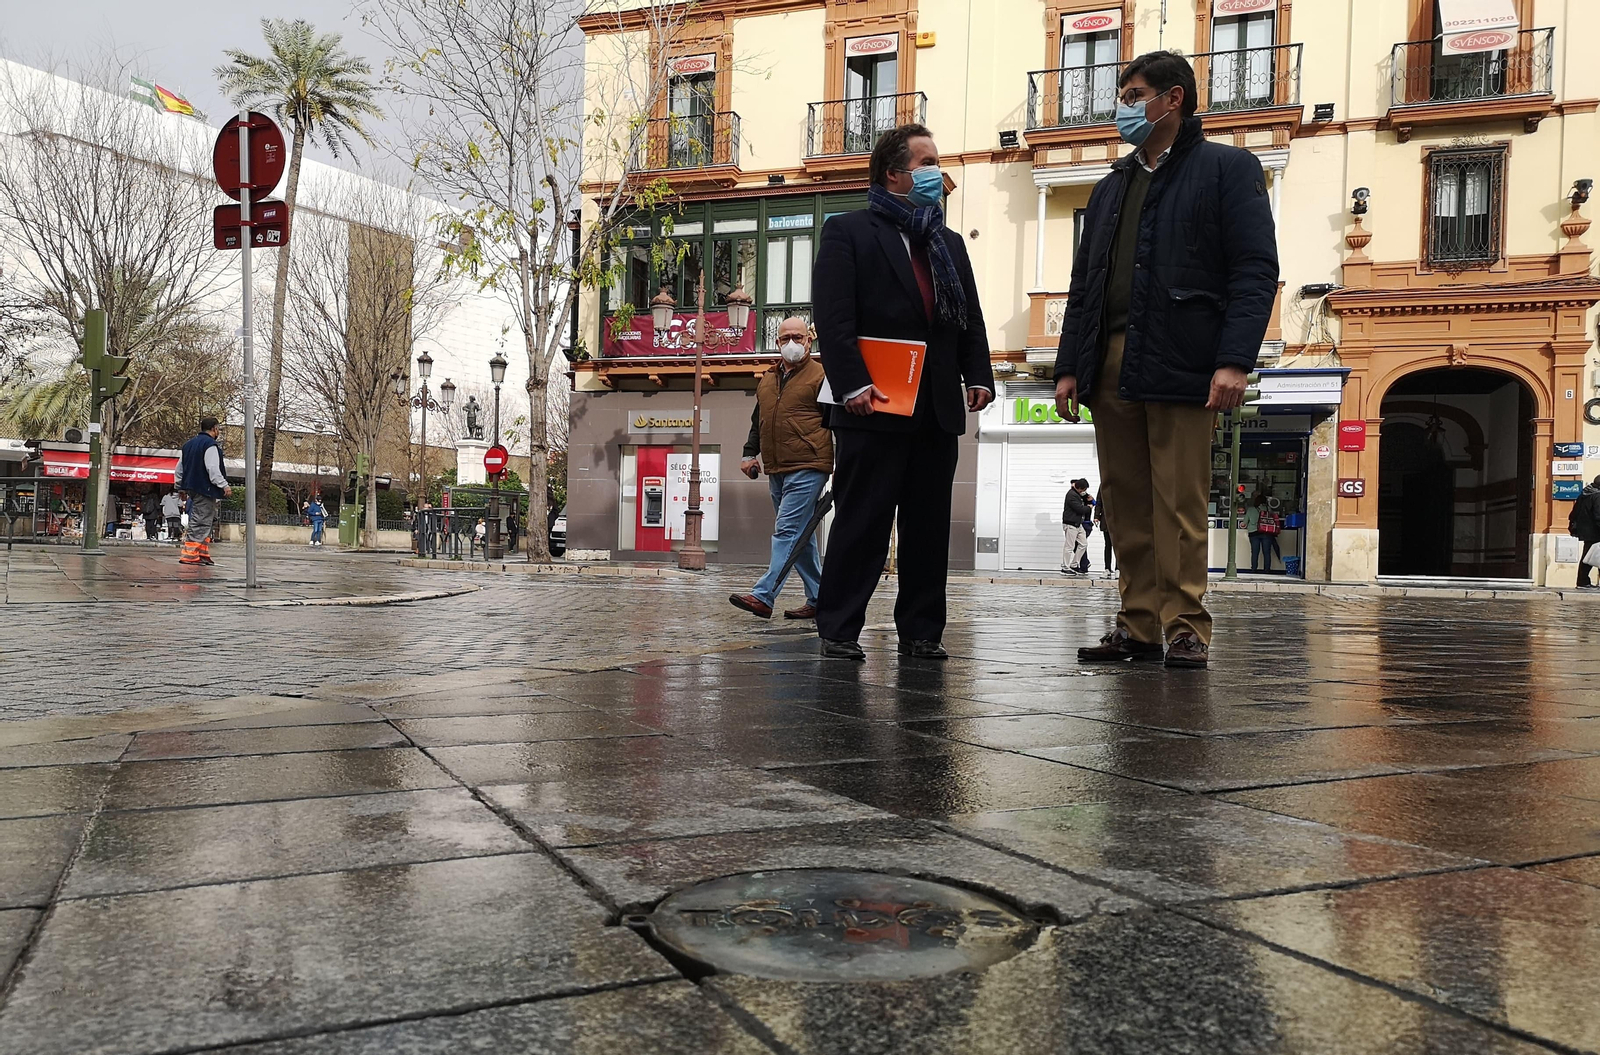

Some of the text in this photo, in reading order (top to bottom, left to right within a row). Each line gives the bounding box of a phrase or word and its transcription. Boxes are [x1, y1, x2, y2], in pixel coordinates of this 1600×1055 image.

[1223, 0, 1268, 9] SVENSON
[1075, 17, 1110, 29] SVENSON
[1445, 15, 1514, 27] 902211020
[854, 40, 889, 51] SVENSON
[1453, 34, 1505, 48] SVENSON
[675, 60, 707, 70] SVENSON
[768, 216, 813, 228] barlovento
[907, 350, 918, 384] Ciudadanos
[1277, 381, 1320, 389] Administración
[1343, 481, 1363, 493] GS
